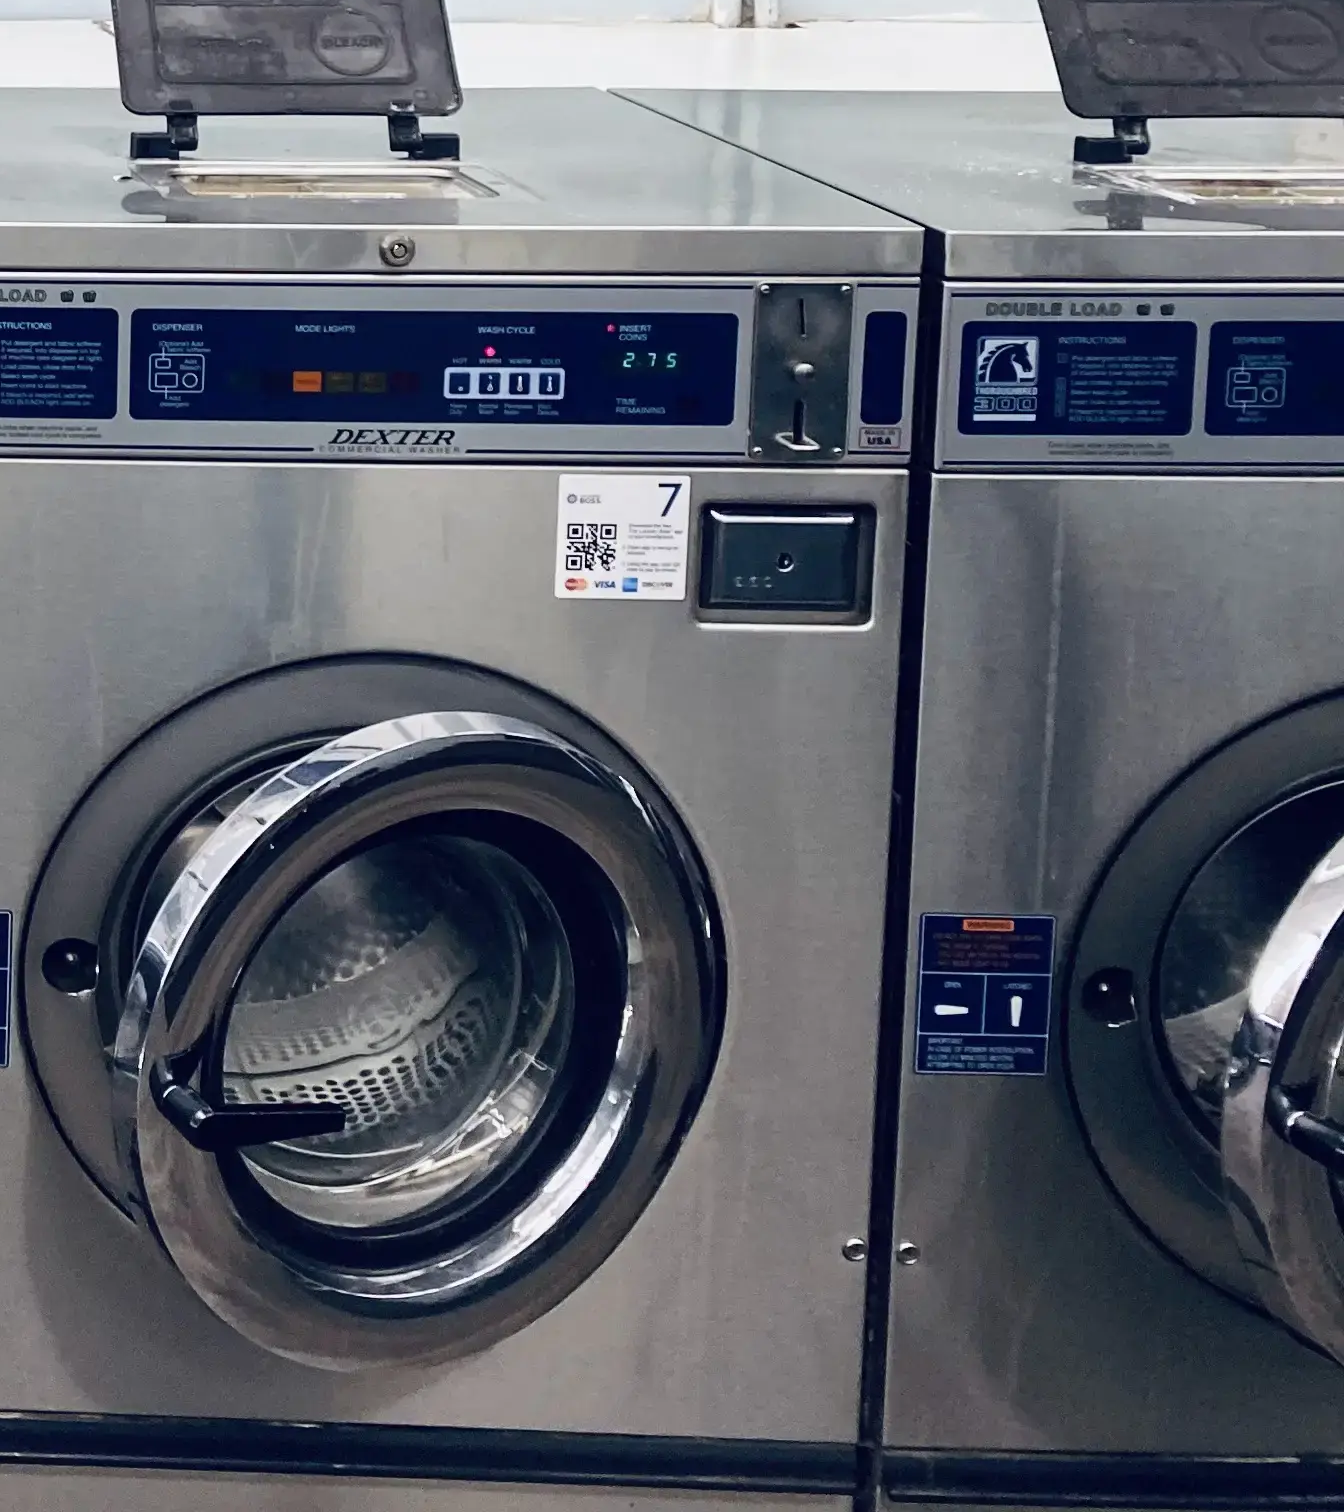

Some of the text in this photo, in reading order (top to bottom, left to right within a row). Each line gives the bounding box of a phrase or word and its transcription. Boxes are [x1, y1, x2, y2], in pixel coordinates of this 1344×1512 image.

[985, 302, 1123, 317] DOUBLE LOAD
[152, 323, 204, 332] DISPENSER
[295, 324, 357, 334] MODE LIGHTS
[477, 325, 536, 335] WASH CYCLE
[618, 324, 653, 333] INSERT
[618, 333, 648, 342] COINS
[615, 406, 666, 415] REMAINING
[328, 428, 456, 445] DEXTER
[318, 445, 461, 455] COMMERCIAL WASHER
[658, 482, 683, 518] 7
[593, 580, 616, 589] VISA
